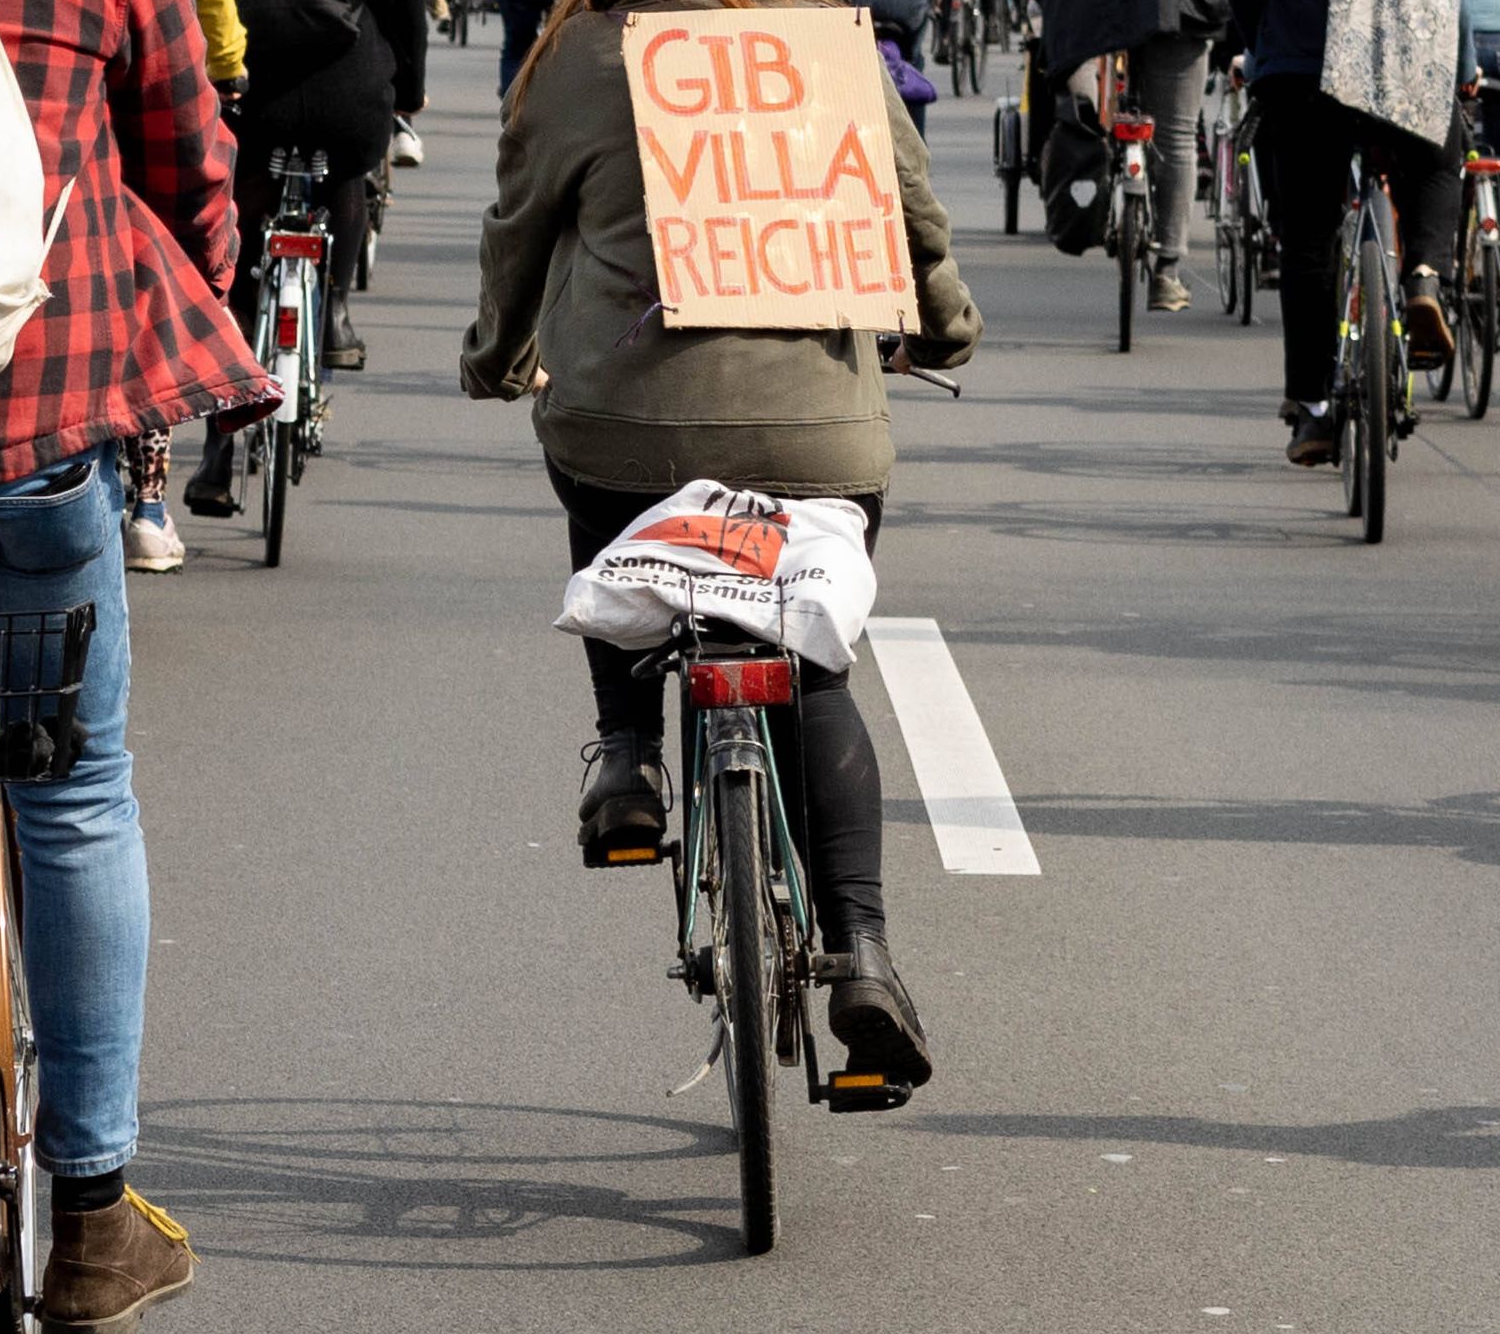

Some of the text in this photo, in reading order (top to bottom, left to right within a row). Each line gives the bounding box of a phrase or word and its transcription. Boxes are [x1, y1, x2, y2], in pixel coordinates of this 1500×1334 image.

[641, 28, 805, 117] GIB
[637, 120, 894, 217] VILLA,
[654, 215, 907, 304] REICHE!
